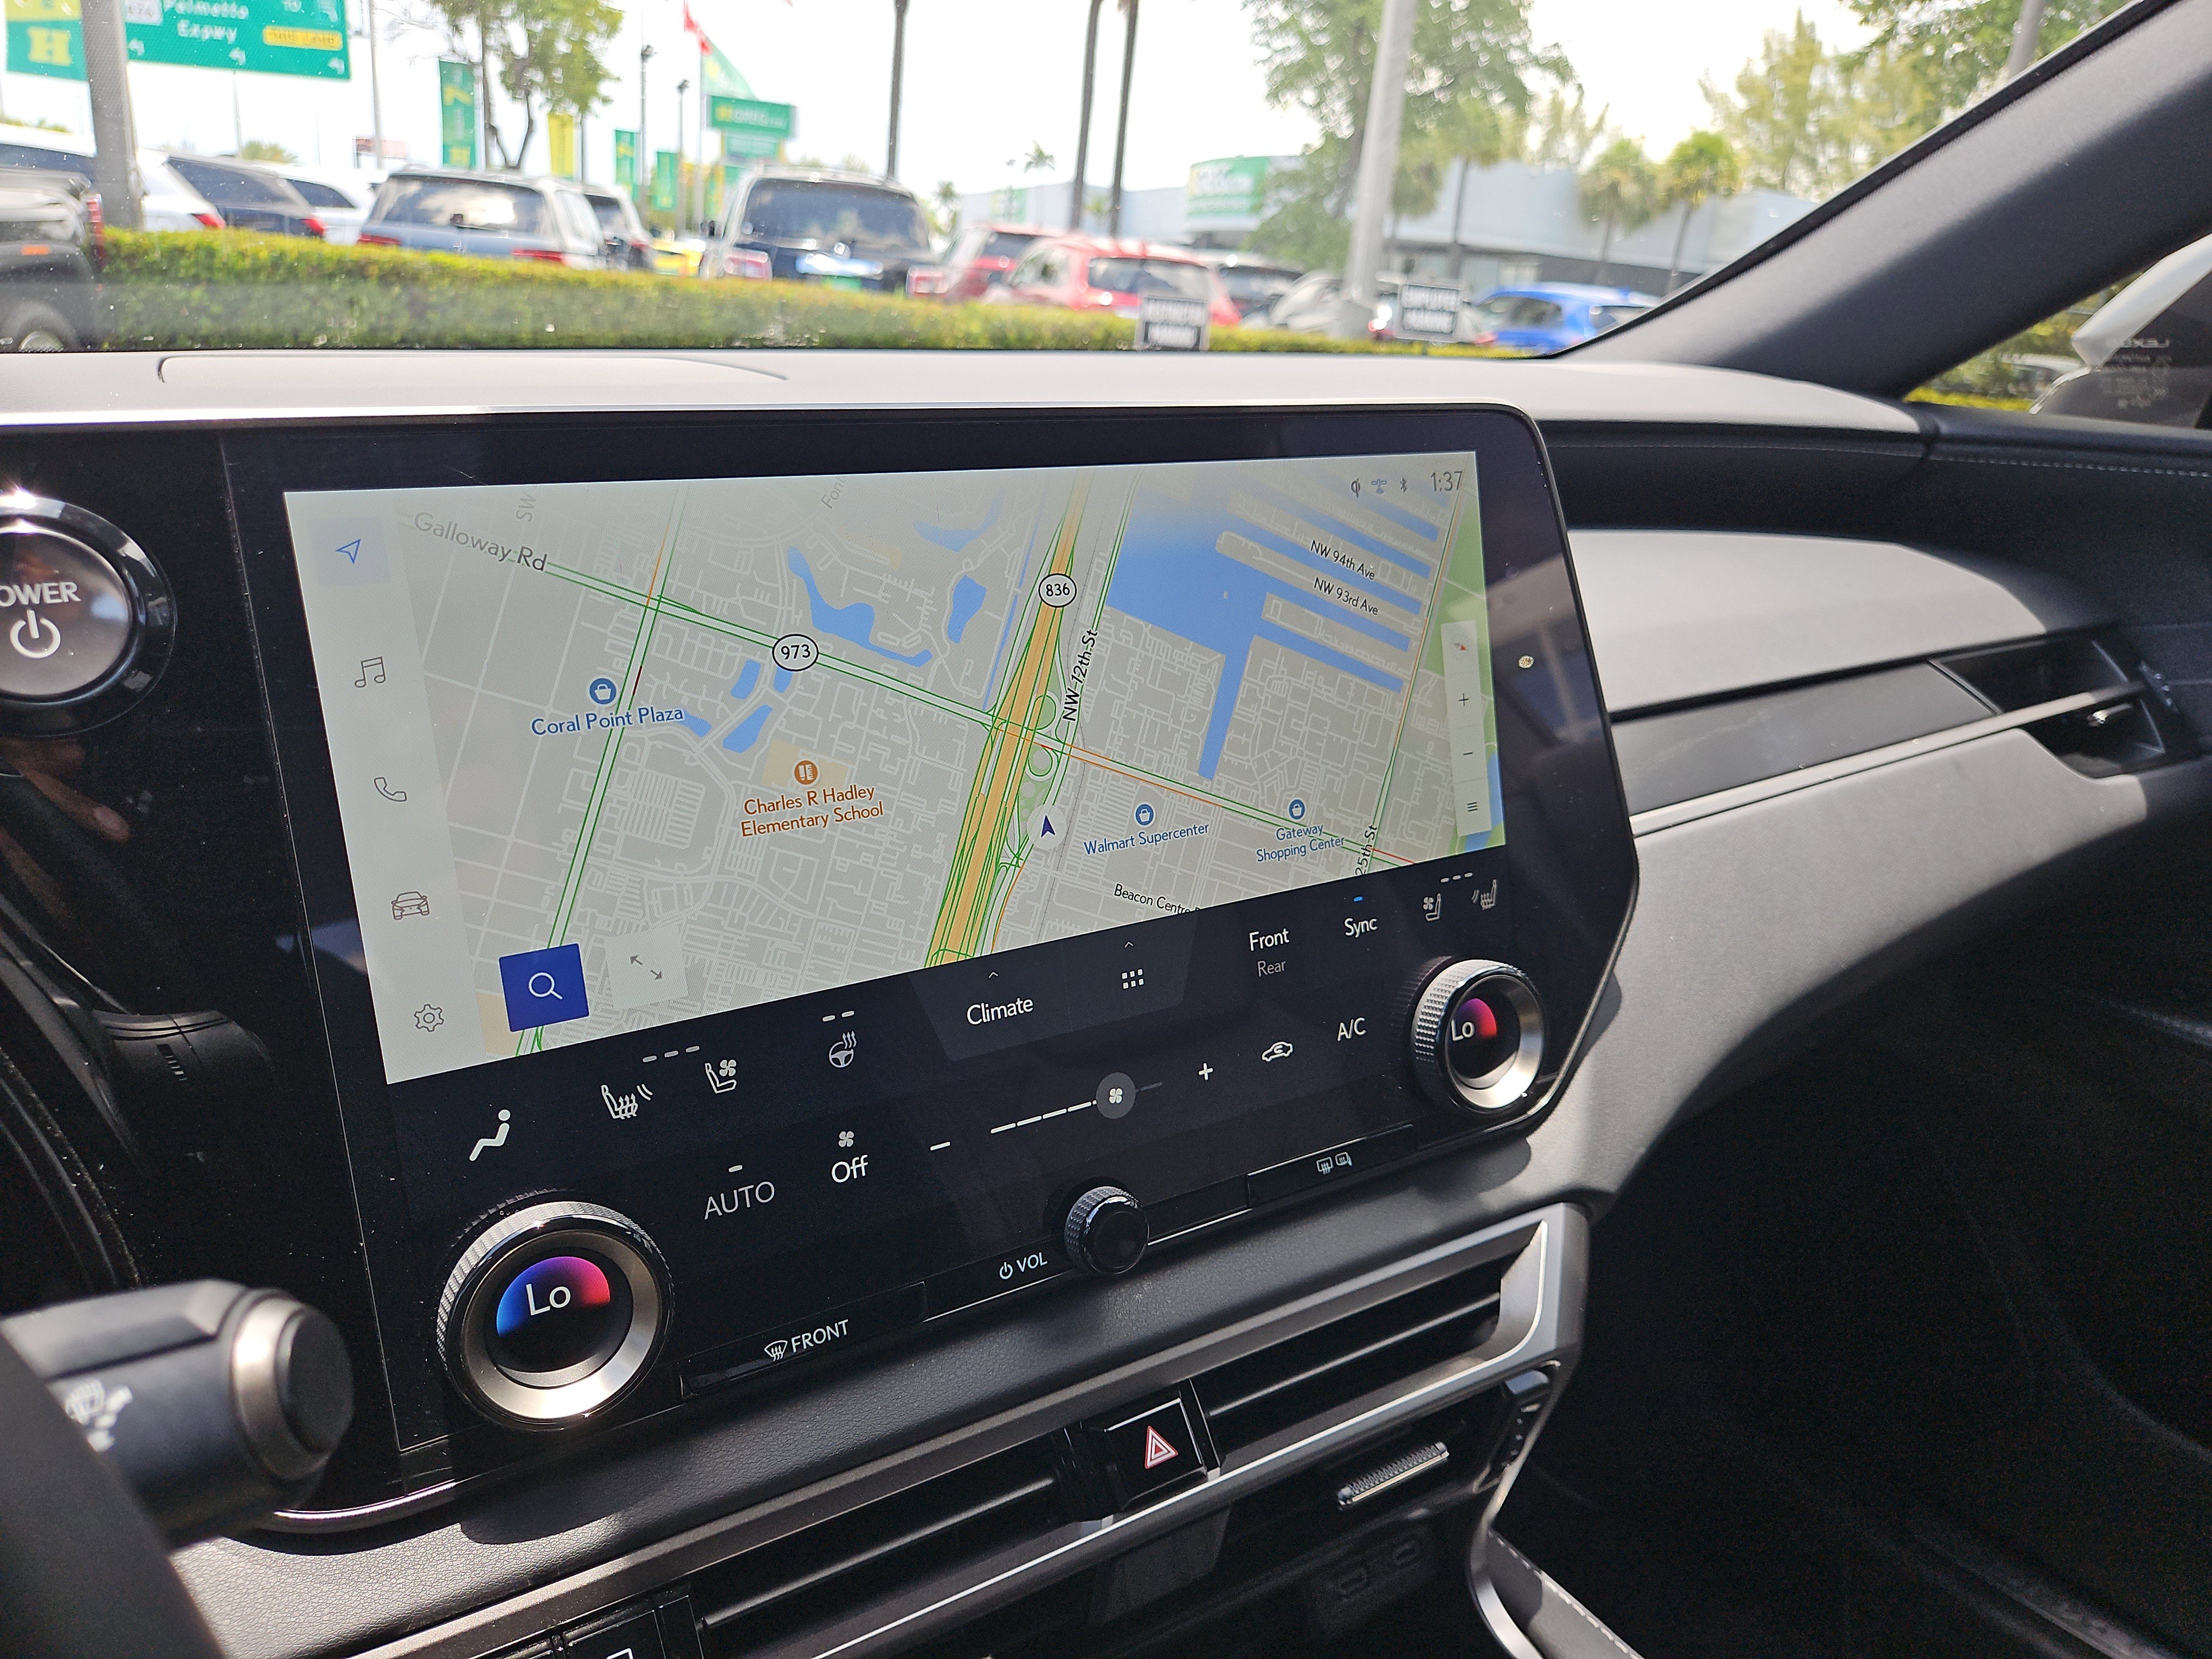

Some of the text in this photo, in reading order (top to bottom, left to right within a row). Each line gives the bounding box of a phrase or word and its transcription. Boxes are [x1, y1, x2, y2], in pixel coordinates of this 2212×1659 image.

[164, 0, 248, 20] Palmetto
[177, 19, 237, 44] Expwy
[1431, 471, 1463, 492] 1:37
[414, 512, 547, 571] Galloway Rd
[1310, 539, 1375, 581] NW 94th Ave
[0, 582, 81, 607] OWER
[1045, 583, 1070, 596] 836
[1314, 577, 1379, 616] NW 93rd Ave
[781, 644, 811, 660] 973
[1063, 629, 1098, 722] NW 12th St
[531, 706, 684, 736] Coral Point Plaza
[744, 785, 875, 815] Charles R Hadley
[741, 801, 883, 837] Elementary School
[1084, 823, 1209, 855] Walmart Supercenter
[1276, 824, 1323, 841] Gateway
[1257, 837, 1345, 862] Shopping Center
[1355, 825, 1377, 875] 25th St
[1114, 884, 1153, 907] Beacon
[1249, 928, 1290, 951] Front
[1344, 918, 1378, 938] Sync
[1257, 961, 1286, 977] Rear
[967, 998, 1033, 1025] Climate
[1338, 1017, 1366, 1041] A/C
[1451, 1020, 1475, 1041] Lo
[832, 1155, 868, 1182] Off
[705, 1181, 775, 1220] AUTO
[1017, 1252, 1047, 1272] VOL
[526, 1283, 571, 1316] Lo
[791, 1320, 849, 1353] FRONT
